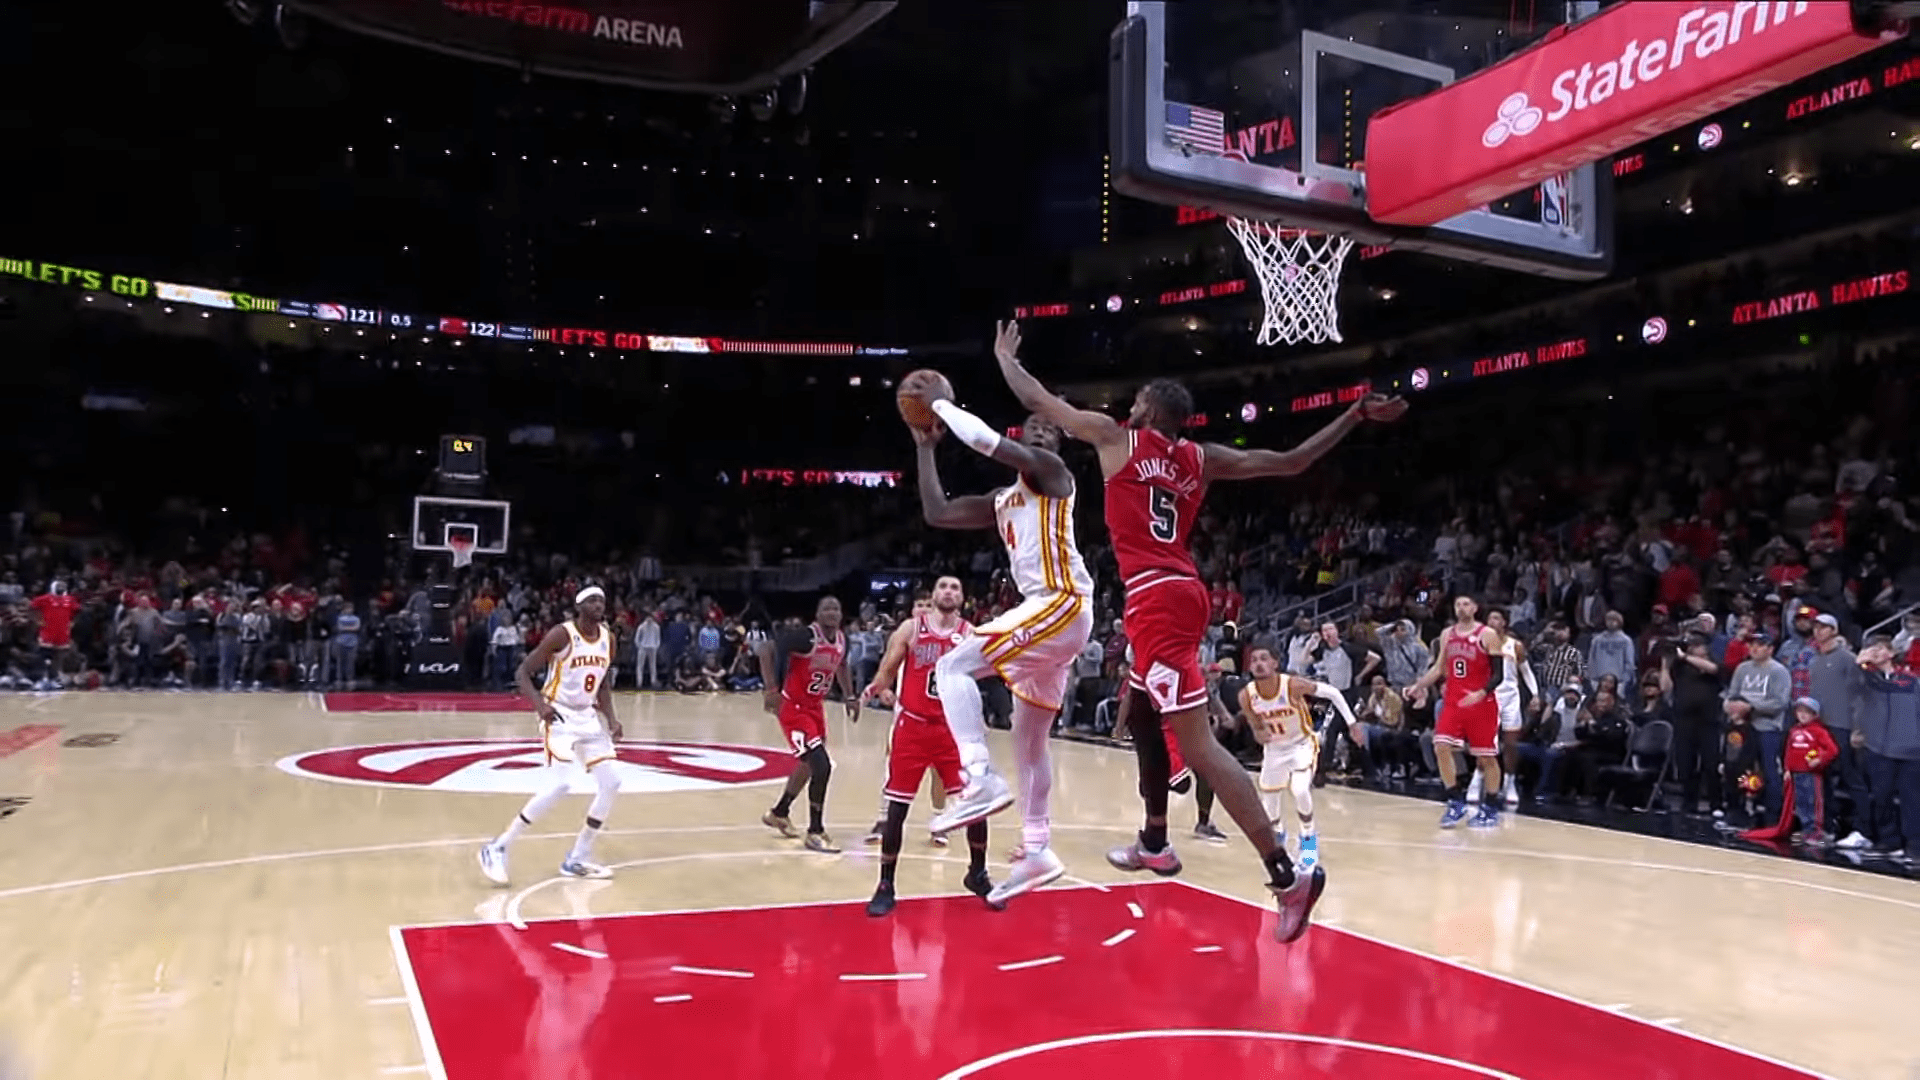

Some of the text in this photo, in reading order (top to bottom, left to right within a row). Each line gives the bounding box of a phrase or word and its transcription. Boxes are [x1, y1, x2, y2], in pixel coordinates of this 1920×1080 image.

[593, 15, 683, 49] ARENA
[1786, 77, 1873, 120] ATLANTA
[24, 260, 103, 291] LET'S
[111, 274, 149, 298] GO
[1732, 271, 1909, 325] ATLANTA HAWKS
[350, 308, 375, 325] 121
[391, 313, 412, 327] 0.5
[469, 321, 495, 337] 122
[551, 329, 607, 346] LET'S
[614, 333, 642, 350] GO
[1473, 338, 1588, 377] ATLANTA HAWKS
[1134, 457, 1180, 481] JONES
[1149, 484, 1178, 543] 5
[1453, 658, 1467, 678] 9
[584, 673, 596, 693] 8
[1268, 723, 1286, 735] 11
